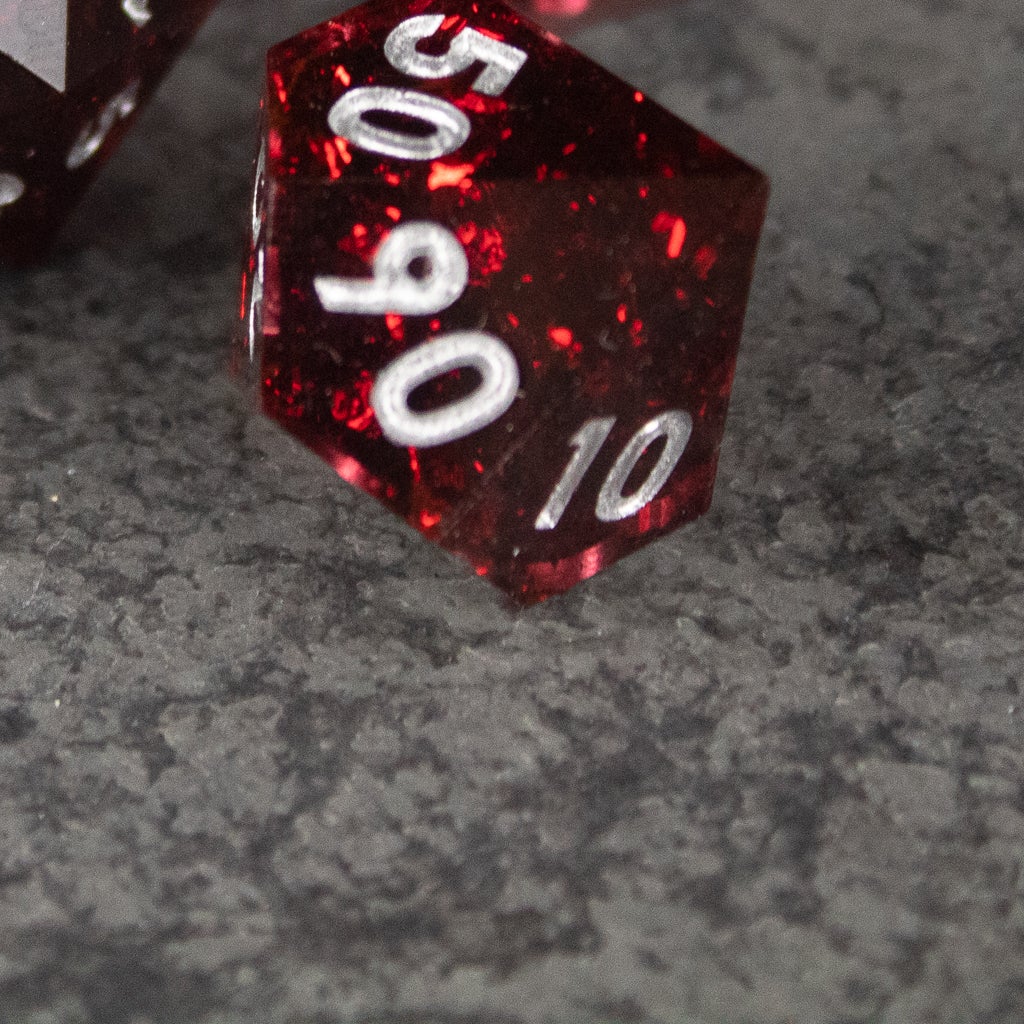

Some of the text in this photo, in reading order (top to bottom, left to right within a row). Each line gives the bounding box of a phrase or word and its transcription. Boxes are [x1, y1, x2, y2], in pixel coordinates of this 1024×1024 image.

[327, 13, 529, 160] 50
[312, 220, 521, 449] 90
[533, 409, 694, 531] 10
